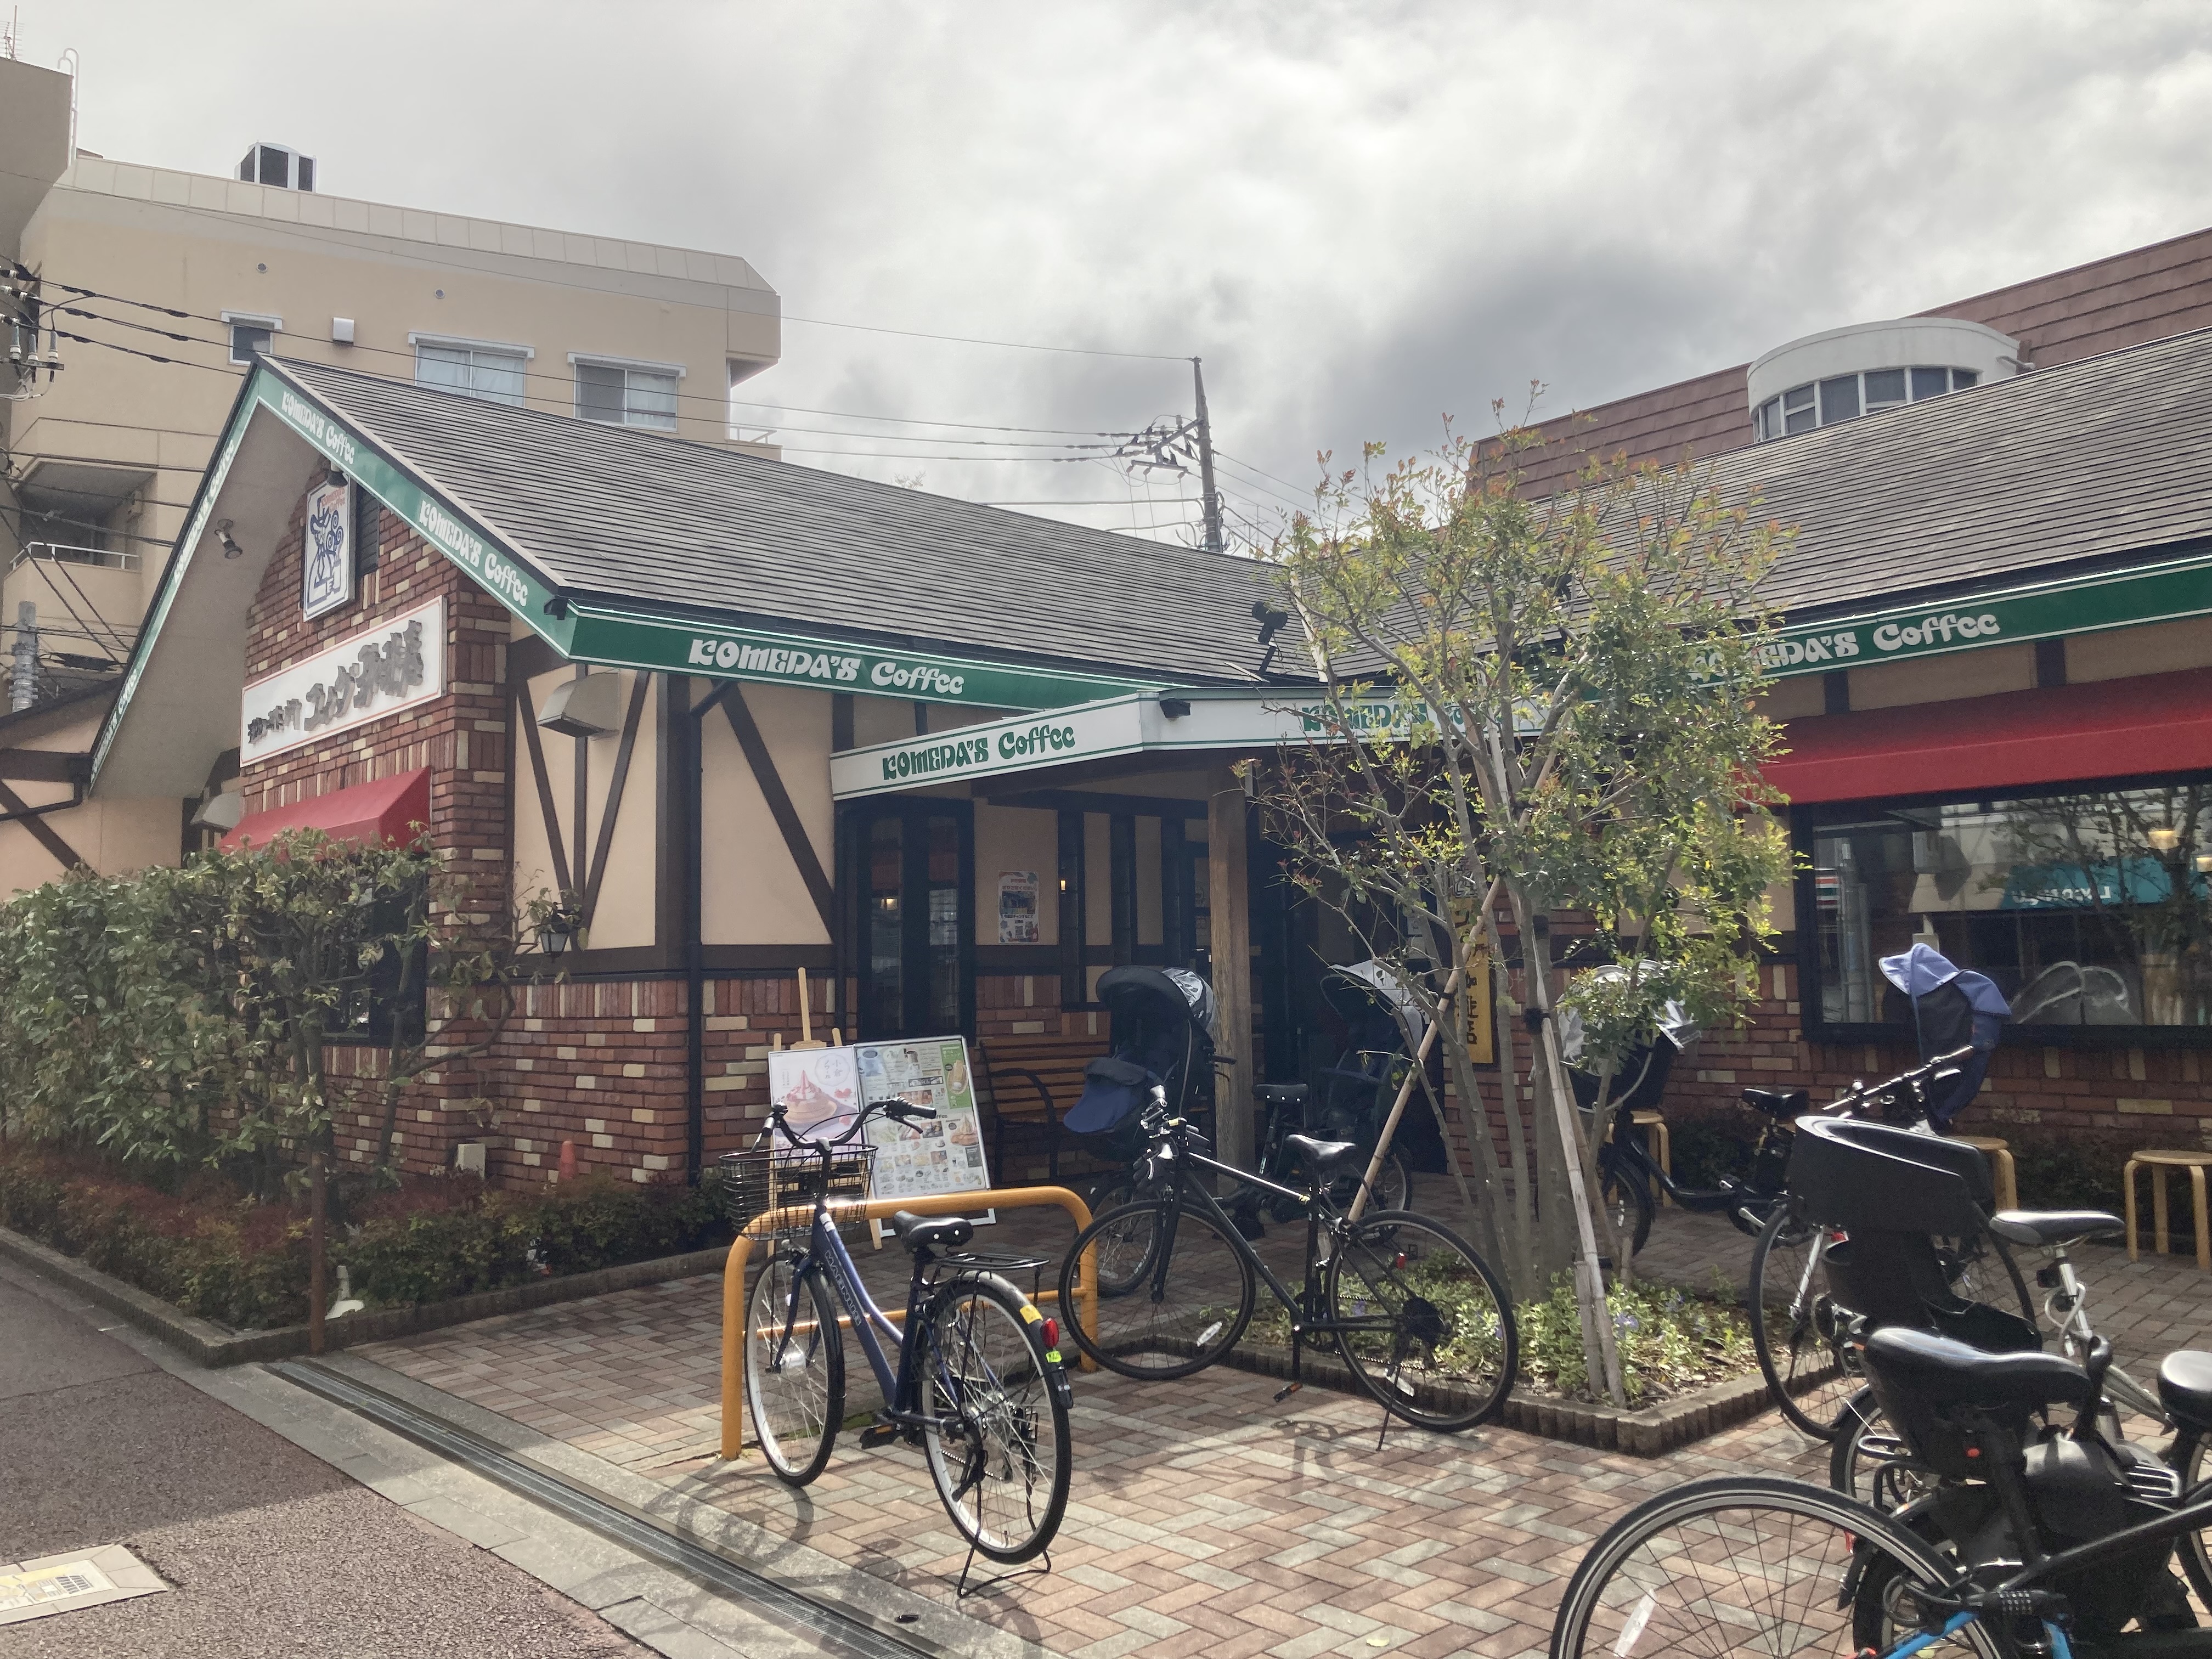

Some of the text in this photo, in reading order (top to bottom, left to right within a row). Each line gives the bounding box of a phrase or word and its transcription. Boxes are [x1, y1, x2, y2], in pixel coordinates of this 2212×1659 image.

[281, 391, 355, 465] KOMEDA'S Coffee
[419, 500, 528, 607] KOMEDA'S Coffee
[1873, 614, 2001, 651] Coffee
[688, 639, 964, 695] KOMEDA'S Coffee
[882, 725, 1075, 780] KOMEDA'S Coffee
